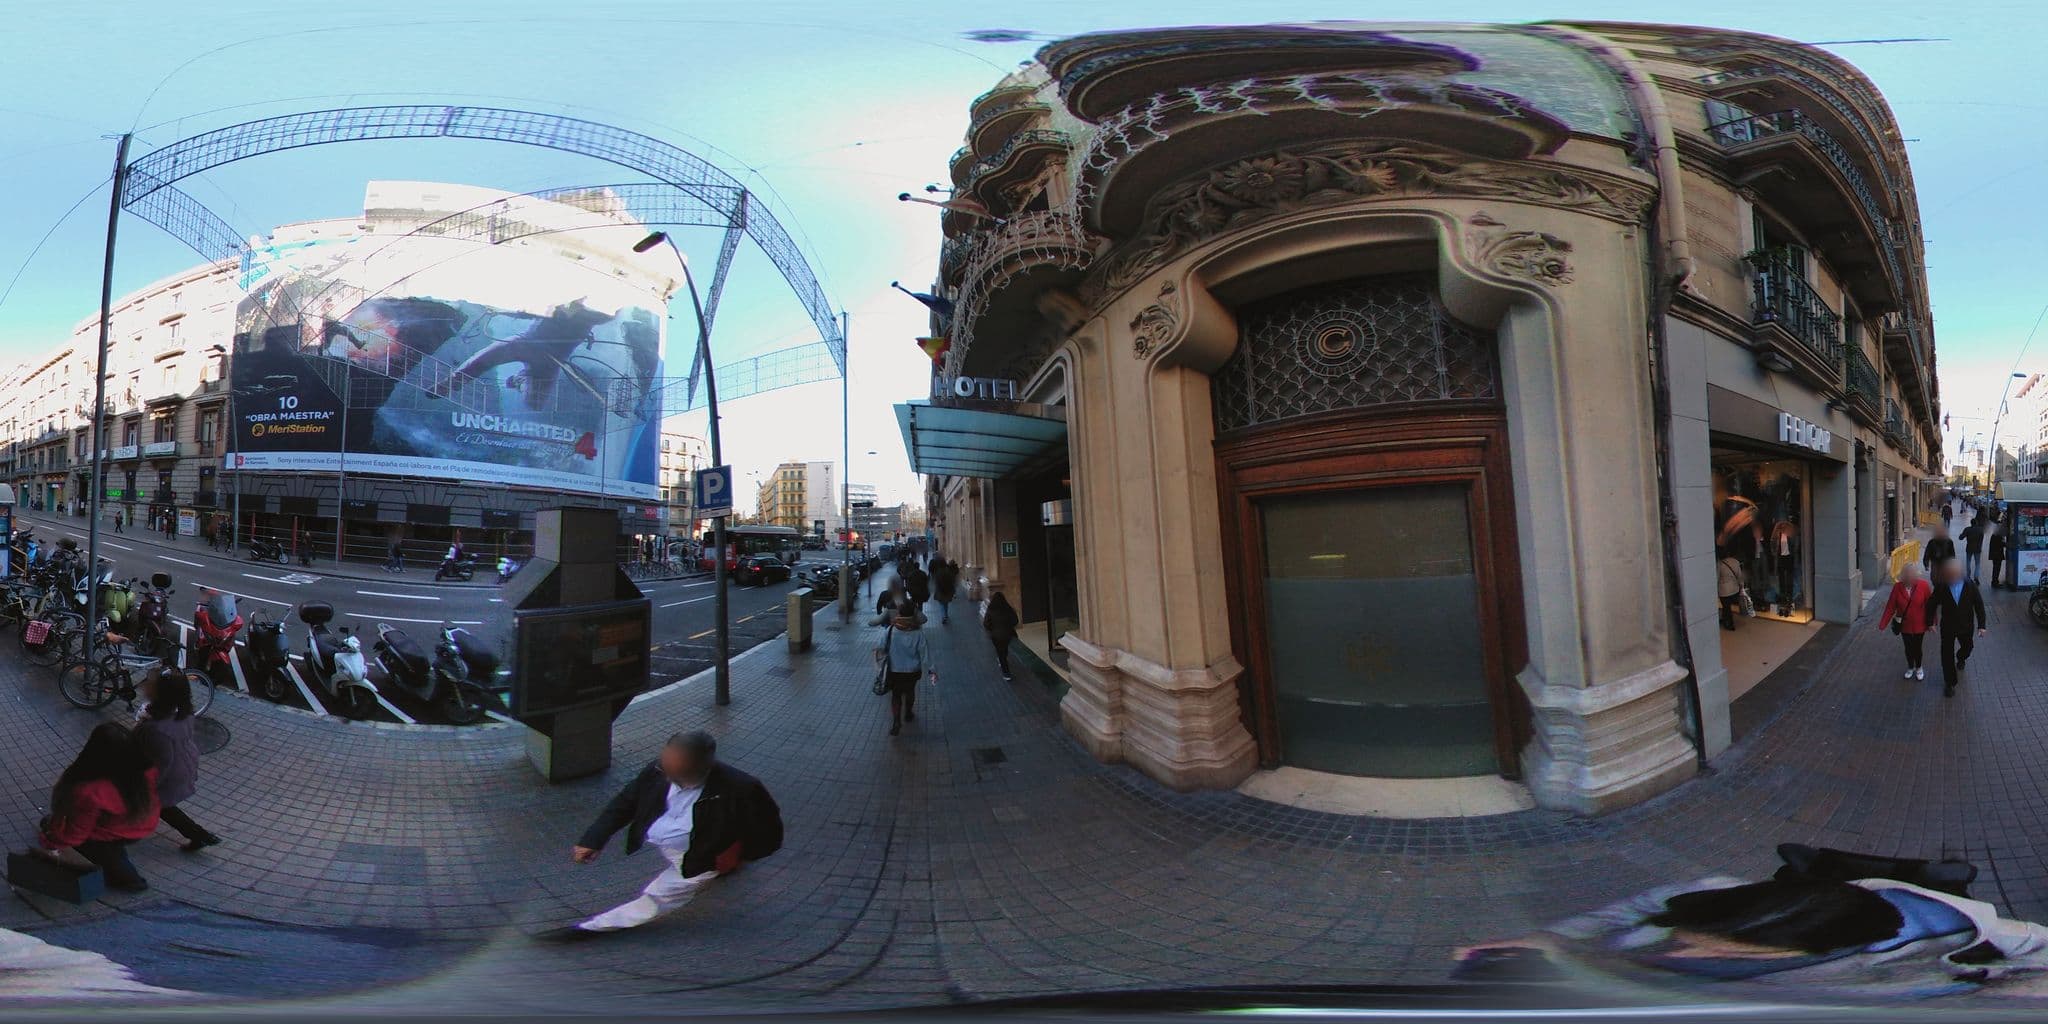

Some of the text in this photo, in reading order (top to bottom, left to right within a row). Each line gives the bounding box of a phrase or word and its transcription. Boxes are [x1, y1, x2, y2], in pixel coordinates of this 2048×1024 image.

[279, 396, 298, 409] 10
[268, 424, 326, 434] MeriStation
[575, 430, 598, 461] 4
[703, 472, 725, 505] P
[1006, 544, 1013, 553] H
